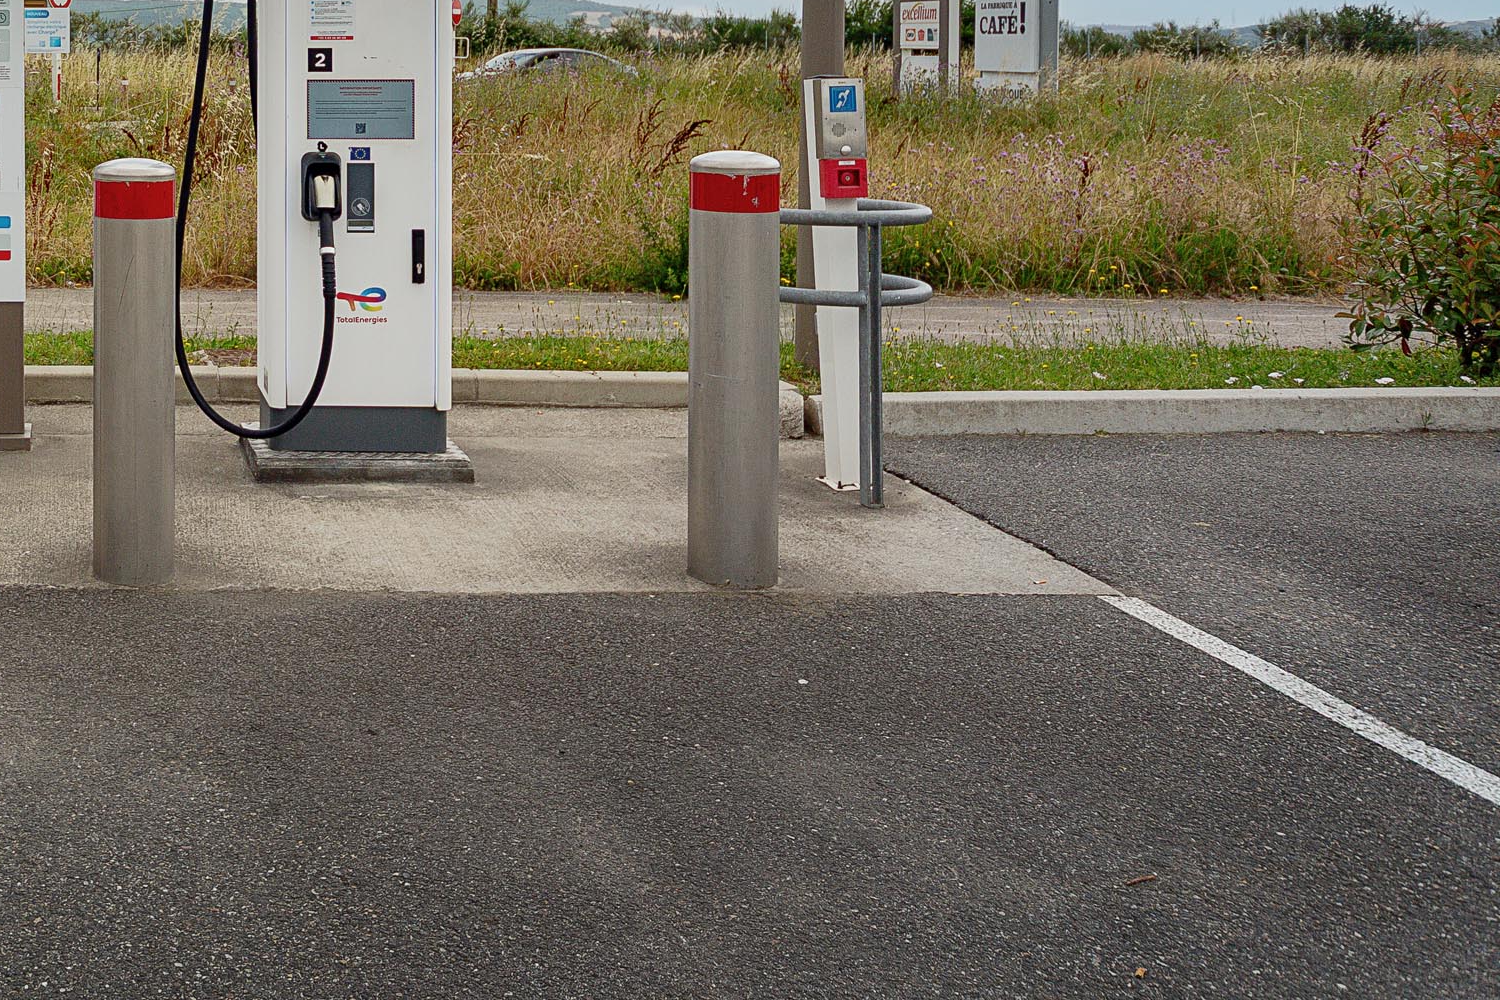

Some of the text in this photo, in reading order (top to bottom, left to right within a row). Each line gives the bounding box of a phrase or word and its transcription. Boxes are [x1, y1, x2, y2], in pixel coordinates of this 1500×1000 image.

[902, 6, 937, 20] excellium
[314, 53, 326, 67] 2
[336, 316, 387, 324] TotalEnergies
